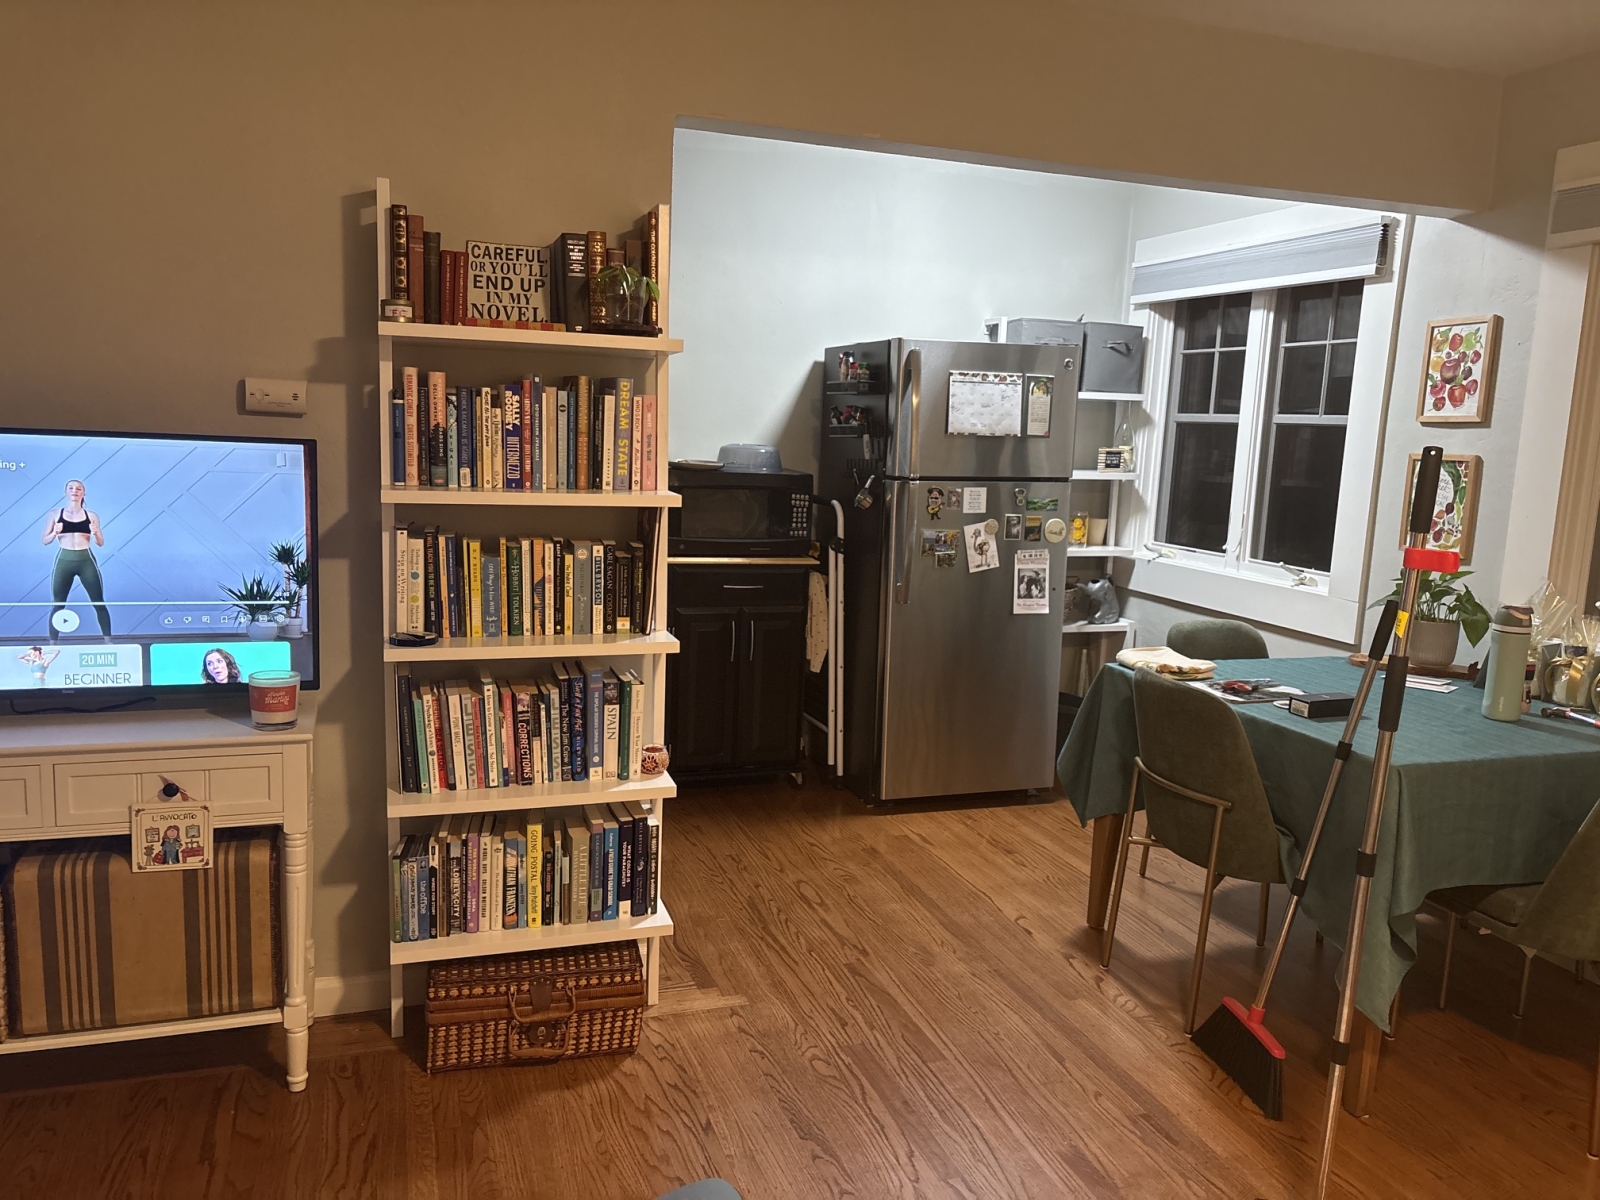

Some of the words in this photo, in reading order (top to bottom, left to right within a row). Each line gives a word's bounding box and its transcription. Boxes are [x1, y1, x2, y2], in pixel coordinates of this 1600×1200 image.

[471, 244, 548, 264] CAREFUL,
[470, 262, 486, 272] OR
[490, 262, 548, 278] YOU'LL
[474, 274, 514, 291] END
[520, 278, 546, 292] UP
[486, 292, 503, 303] IN
[508, 293, 532, 305] MY
[471, 303, 549, 322] NOVEL.
[619, 381, 630, 430] DREAM
[506, 436, 520, 478] INTERMEZZO
[617, 439, 628, 476] STATE
[82, 654, 94, 665] 20
[96, 654, 115, 665] MIN
[64, 673, 132, 686] BEGINNER
[552, 698, 560, 769] LESS
[606, 707, 617, 740] SPAIN
[464, 704, 476, 776] LESS
[518, 722, 531, 778] CORRECTIONS
[152, 813, 197, 822] L'AVVOCATO
[506, 854, 516, 885] JONATHAN
[506, 887, 516, 916] FRANZEN
[530, 885, 538, 895] Terry
